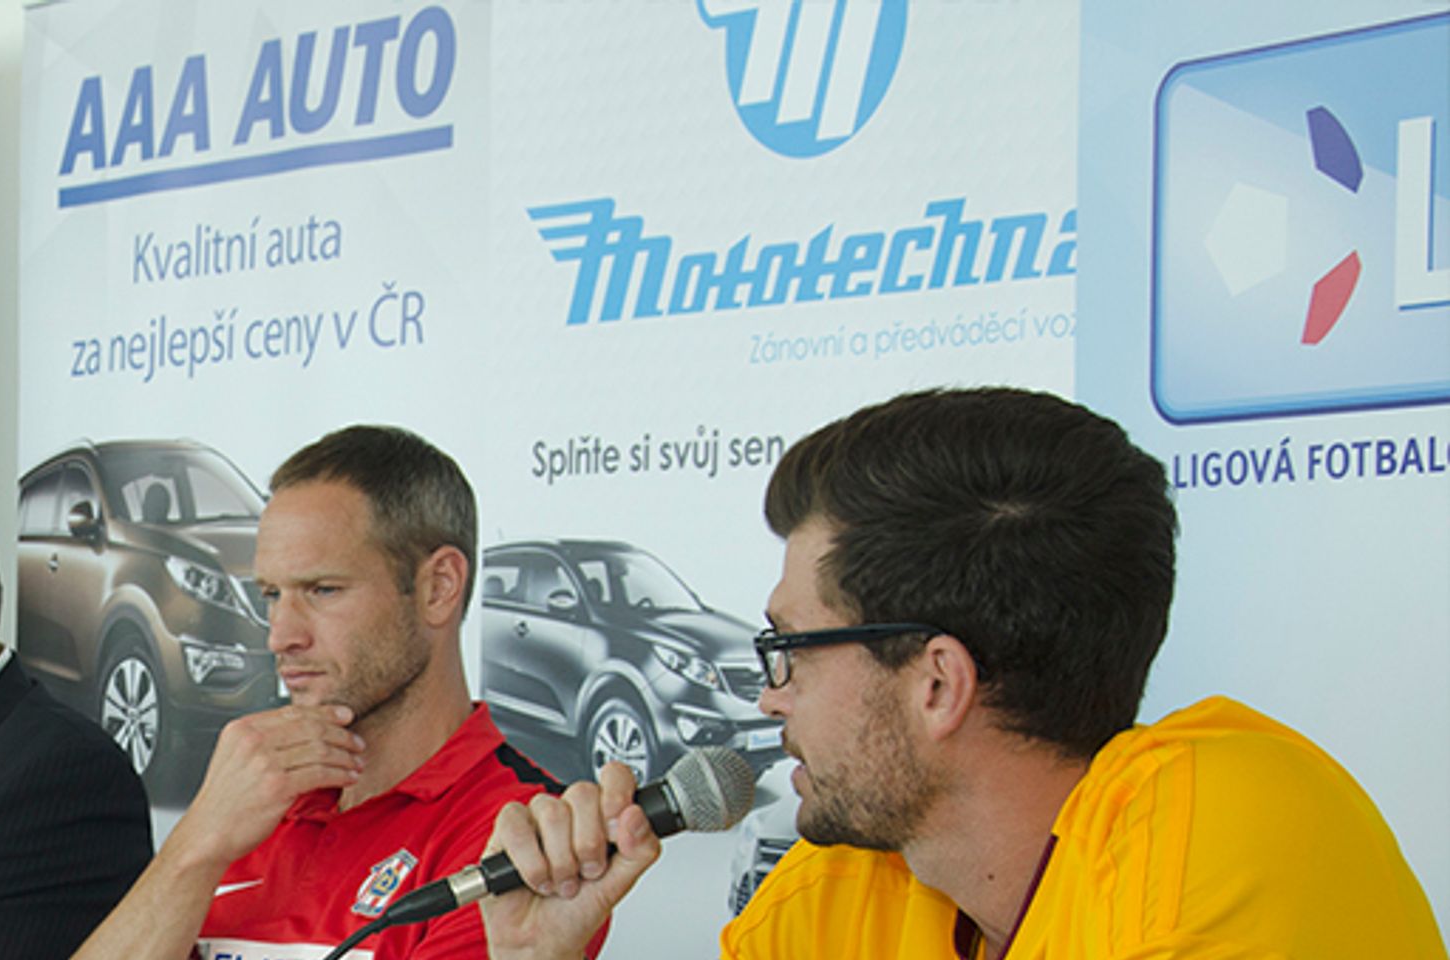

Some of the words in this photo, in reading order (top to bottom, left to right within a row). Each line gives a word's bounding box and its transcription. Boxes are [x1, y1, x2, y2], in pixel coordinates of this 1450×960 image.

[59, 55, 211, 177] AAA
[233, 6, 456, 148] AUTO
[133, 217, 259, 283] Kvalitní
[266, 216, 341, 267] auta
[71, 339, 101, 376] za
[108, 309, 237, 383] nejlepší
[244, 312, 323, 368] ceny
[333, 311, 359, 349] v
[368, 281, 425, 347] ČR
[750, 326, 844, 364] Zánovní
[851, 332, 868, 356] a
[875, 308, 1028, 359] předváděcí
[532, 436, 620, 485] Splňte
[630, 435, 651, 468] si
[659, 425, 720, 478] svůj
[730, 437, 786, 467] sen
[1173, 437, 1295, 490] LIGOVÁ
